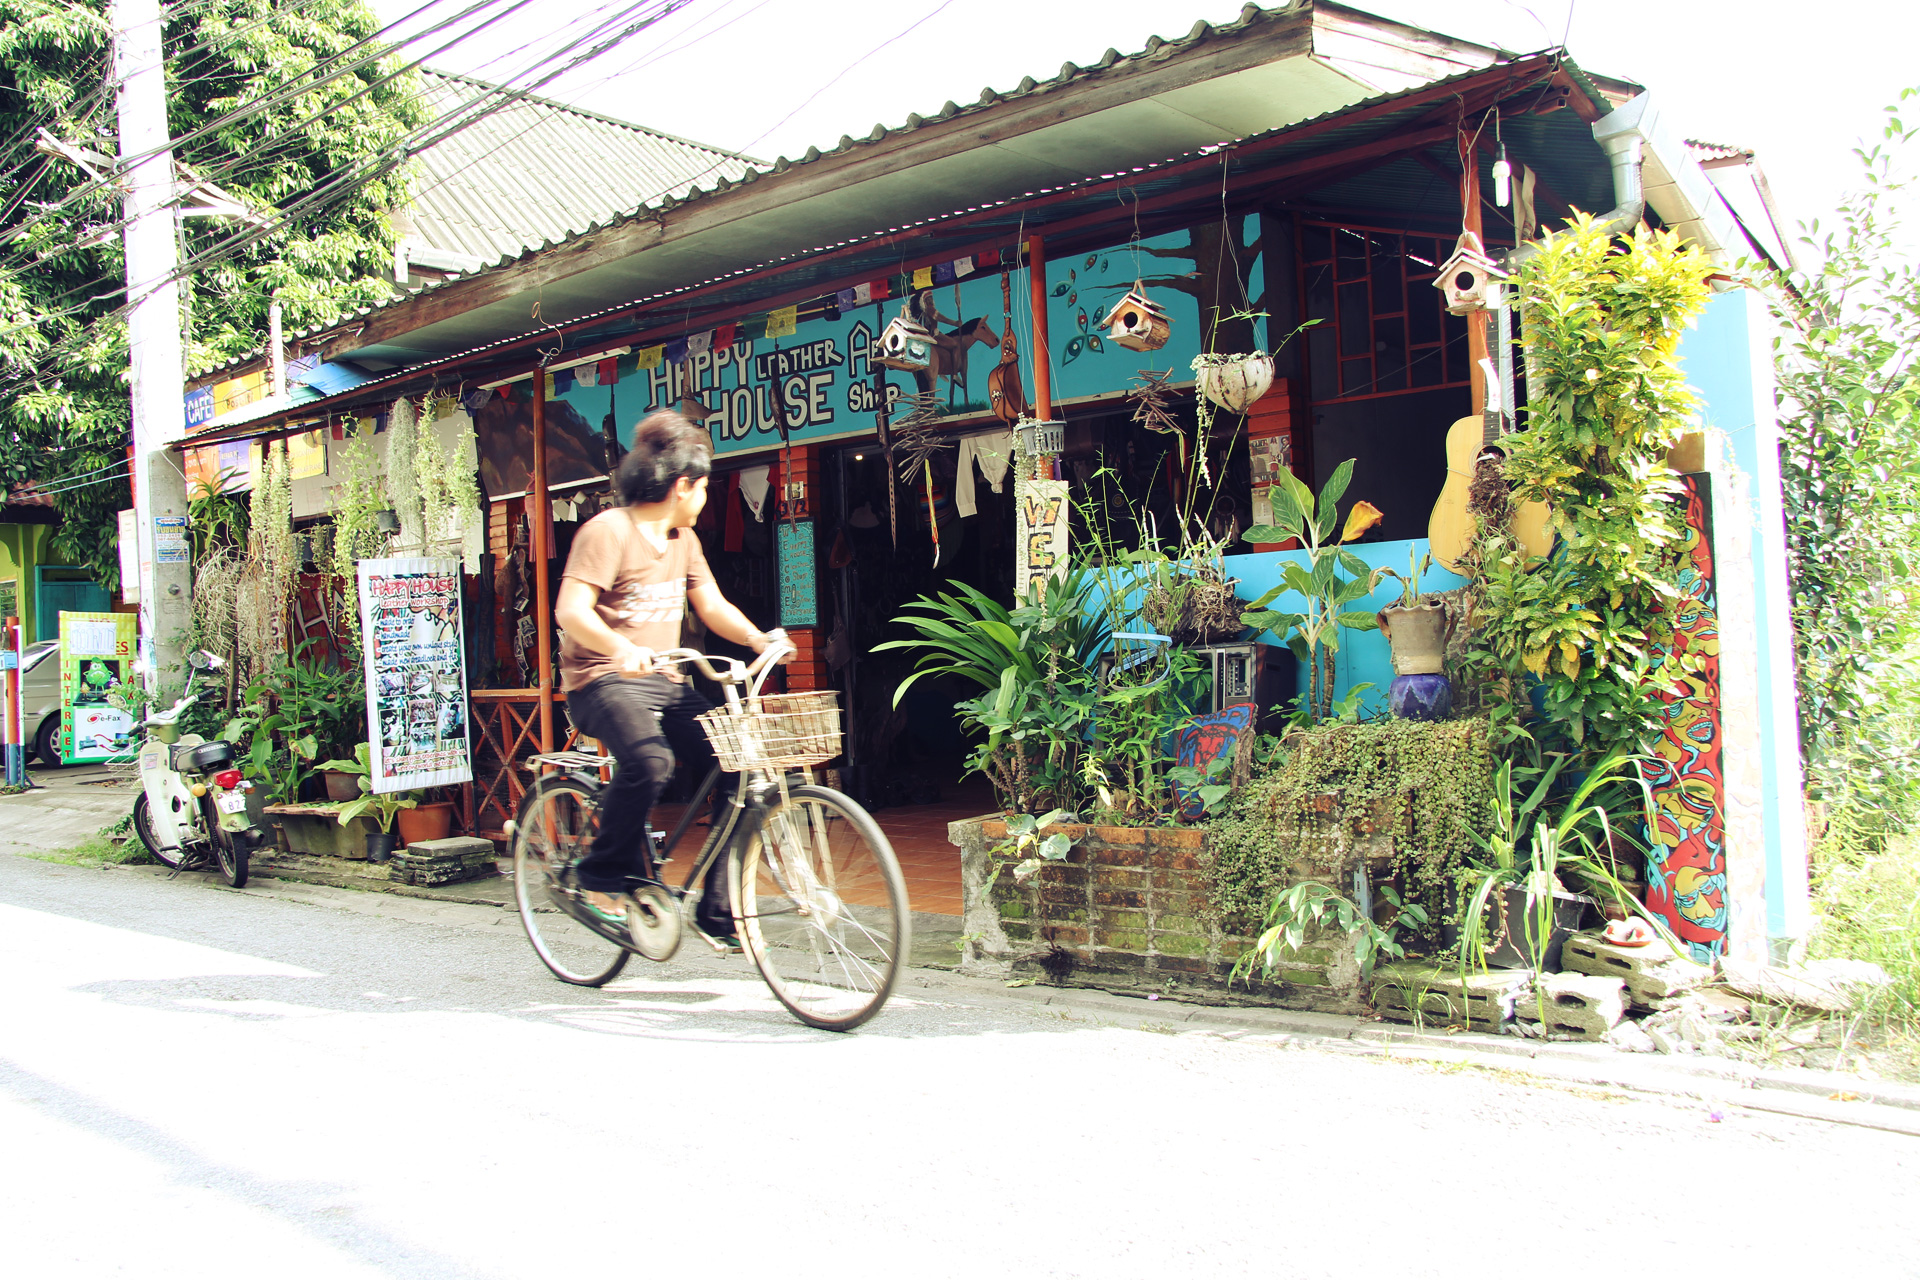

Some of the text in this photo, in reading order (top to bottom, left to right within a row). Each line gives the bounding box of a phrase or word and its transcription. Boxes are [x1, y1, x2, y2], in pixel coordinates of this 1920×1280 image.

[701, 370, 901, 441] HOUSE Shp
[372, 577, 454, 599] HAPPY HOUSE
[410, 596, 449, 608] workshop
[127, 660, 135, 700] FAX
[63, 660, 72, 758] INTERNET
[100, 714, 121, 722] e-Fax
[201, 743, 225, 753] HONDA
